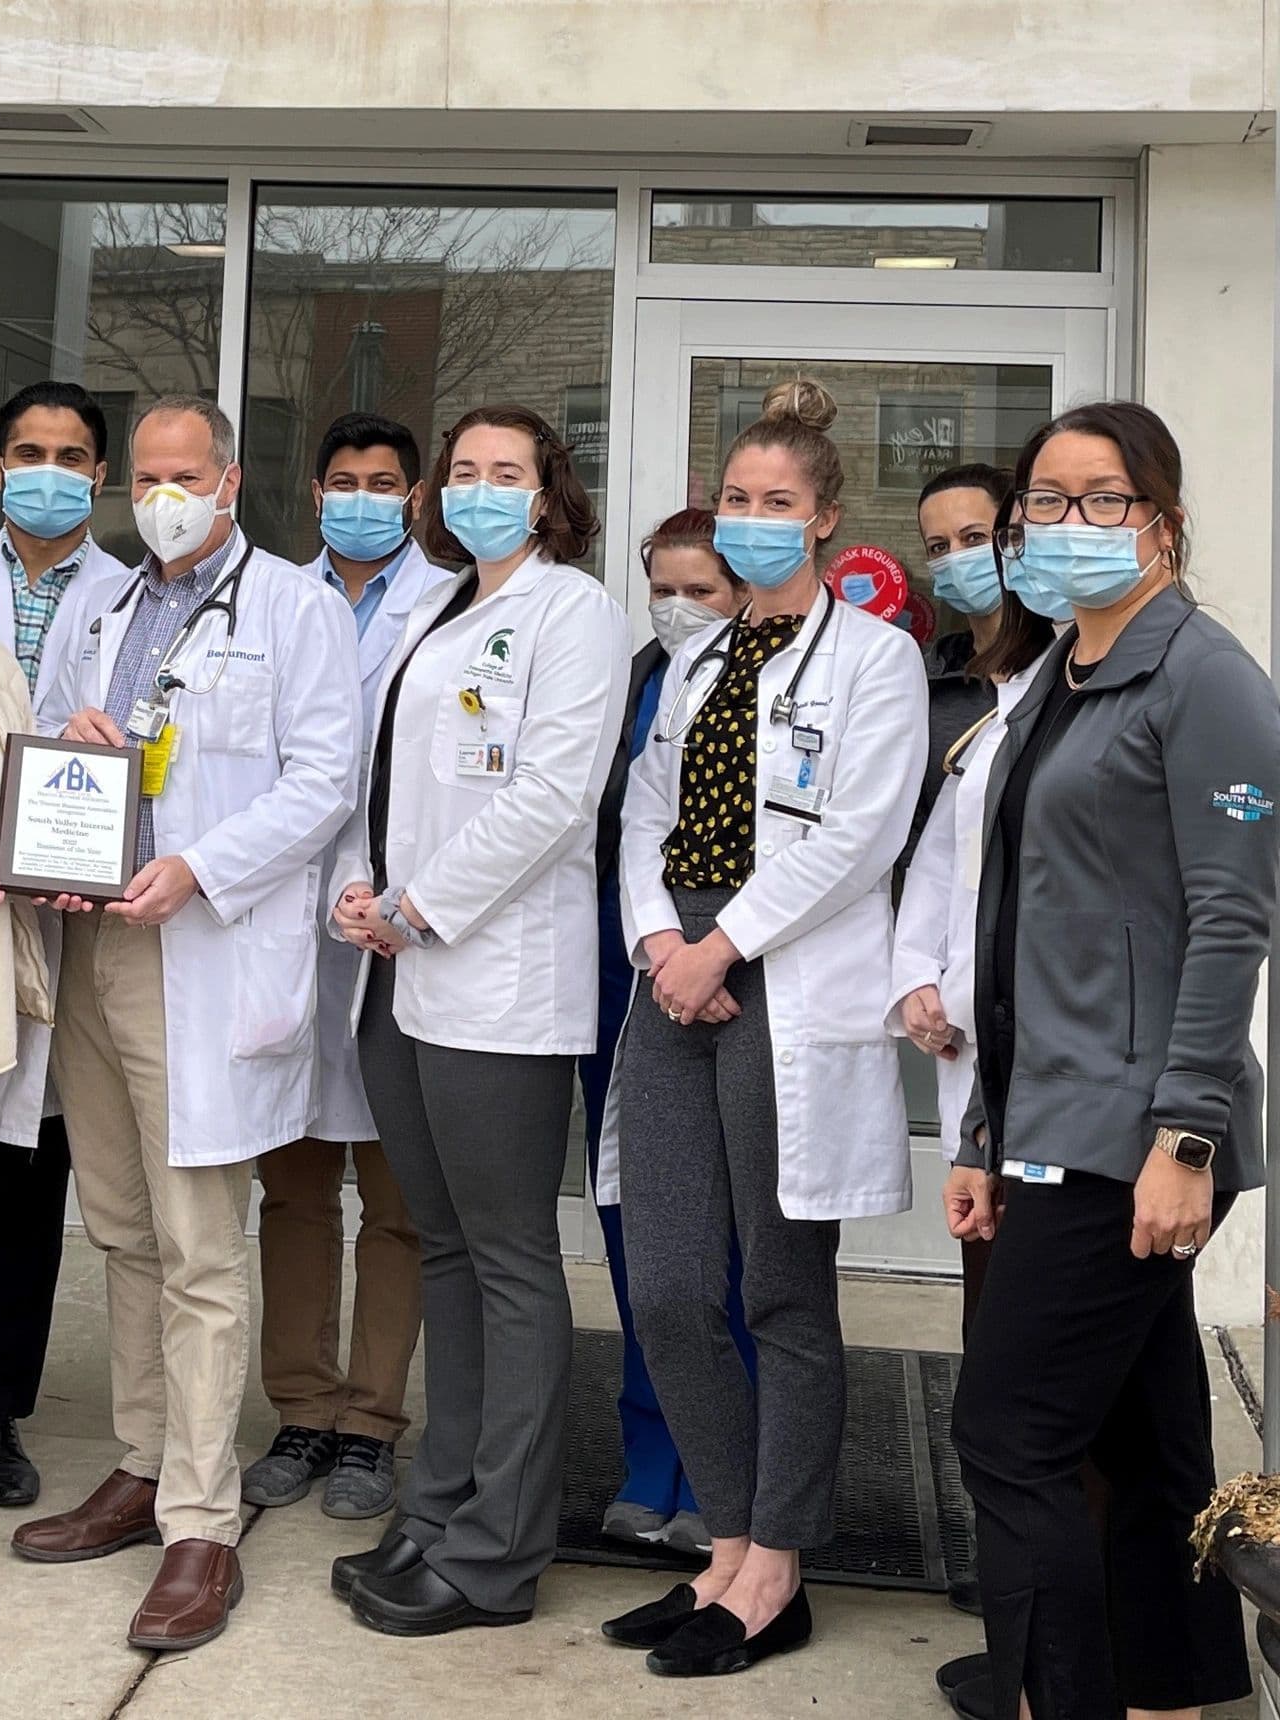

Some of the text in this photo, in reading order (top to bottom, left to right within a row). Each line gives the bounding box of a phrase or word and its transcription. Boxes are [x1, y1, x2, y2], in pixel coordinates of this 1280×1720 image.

[861, 547, 904, 585] REQUIRED
[1213, 791, 1245, 803] SOUTH
[1247, 796, 1274, 809] VALLEY
